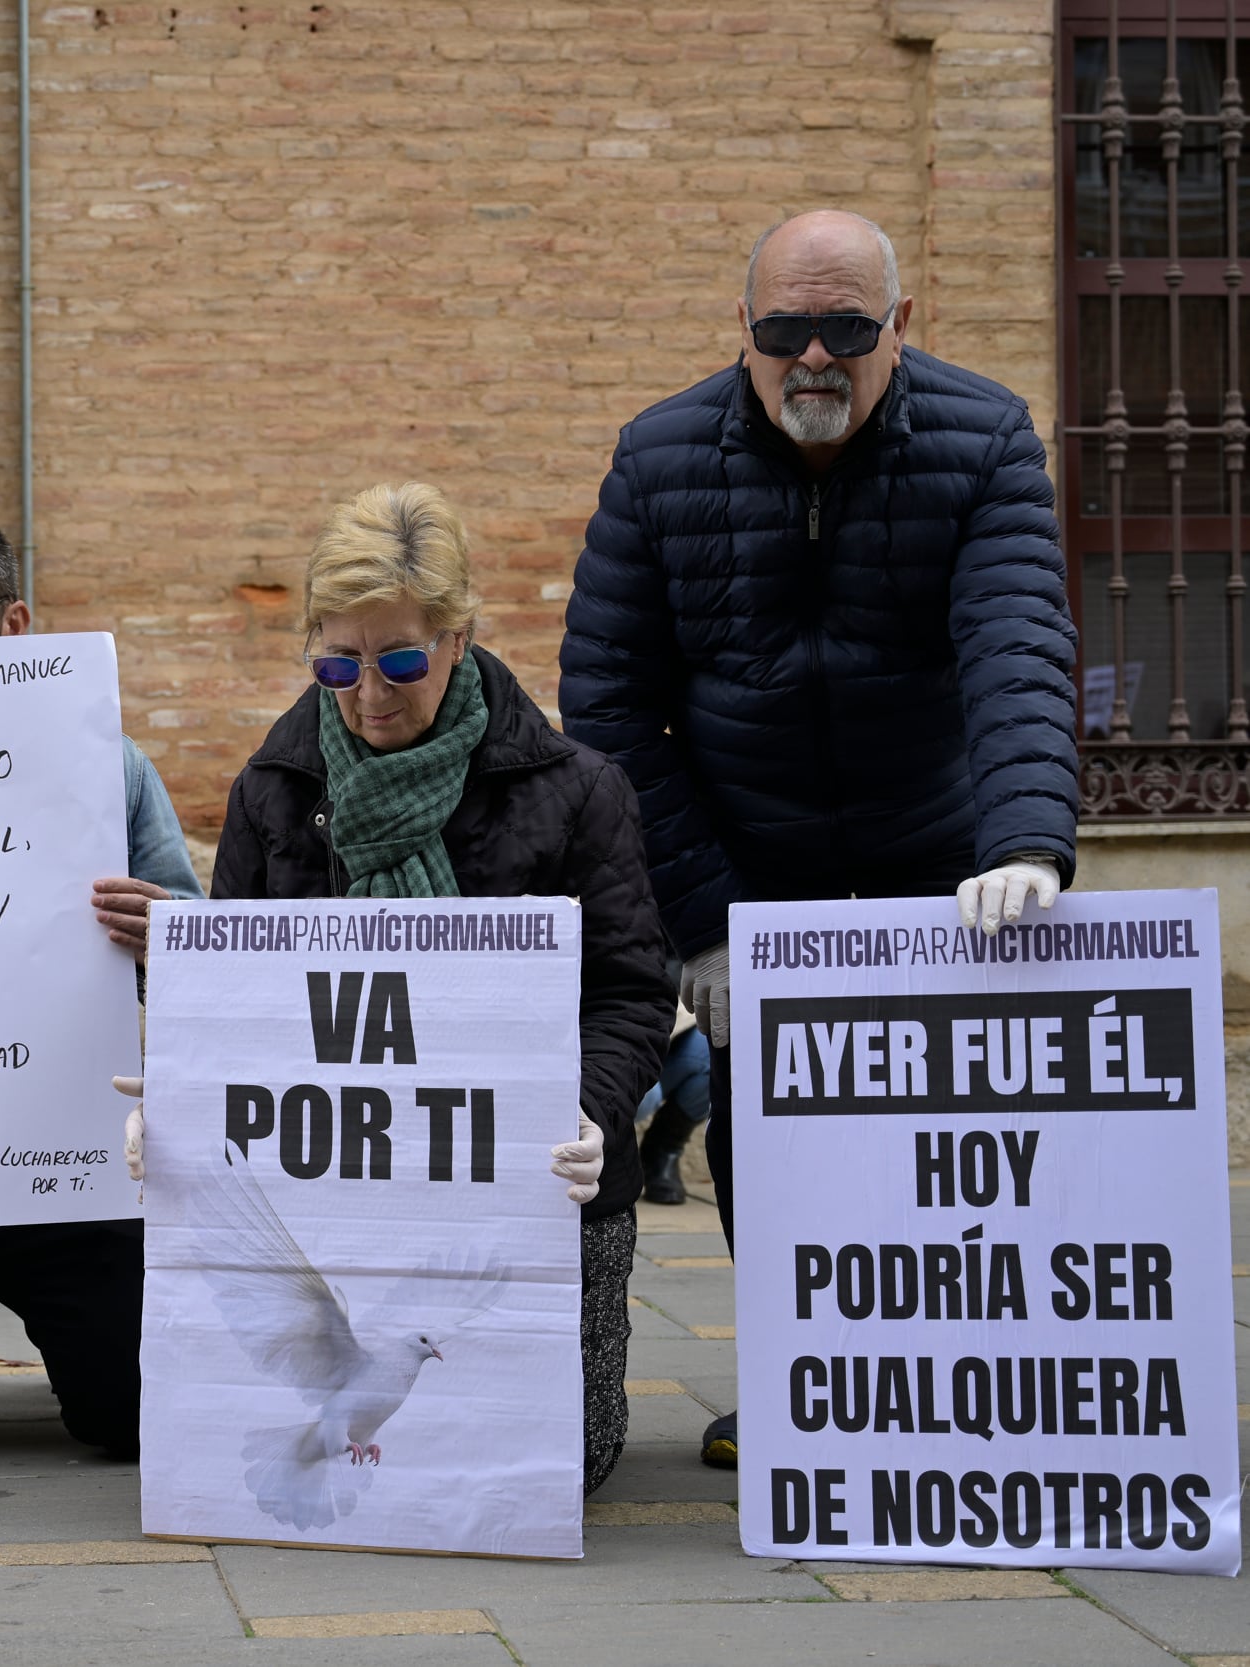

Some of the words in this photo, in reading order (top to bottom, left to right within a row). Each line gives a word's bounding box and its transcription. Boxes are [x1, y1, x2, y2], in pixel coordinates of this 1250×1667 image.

[165, 907, 559, 953] #JUSTICIAPARAVÍCTORMANUEL
[306, 972, 417, 1065] VA
[773, 1020, 928, 1099] AYER
[951, 1016, 1066, 1097] FUE
[1087, 994, 1184, 1103] ÉL,
[0, 1146, 108, 1167] LUCHAREMOS
[225, 1084, 393, 1180] POR
[415, 1088, 495, 1183] TI
[914, 1130, 1040, 1208] HOY
[32, 1177, 58, 1194] POR
[794, 1222, 1028, 1321] PODRÍA
[1050, 1242, 1173, 1321] SER
[789, 1355, 1187, 1442] CUALQUIERA
[770, 1468, 848, 1546] DE
[871, 1469, 1212, 1551] NOSOTROS
